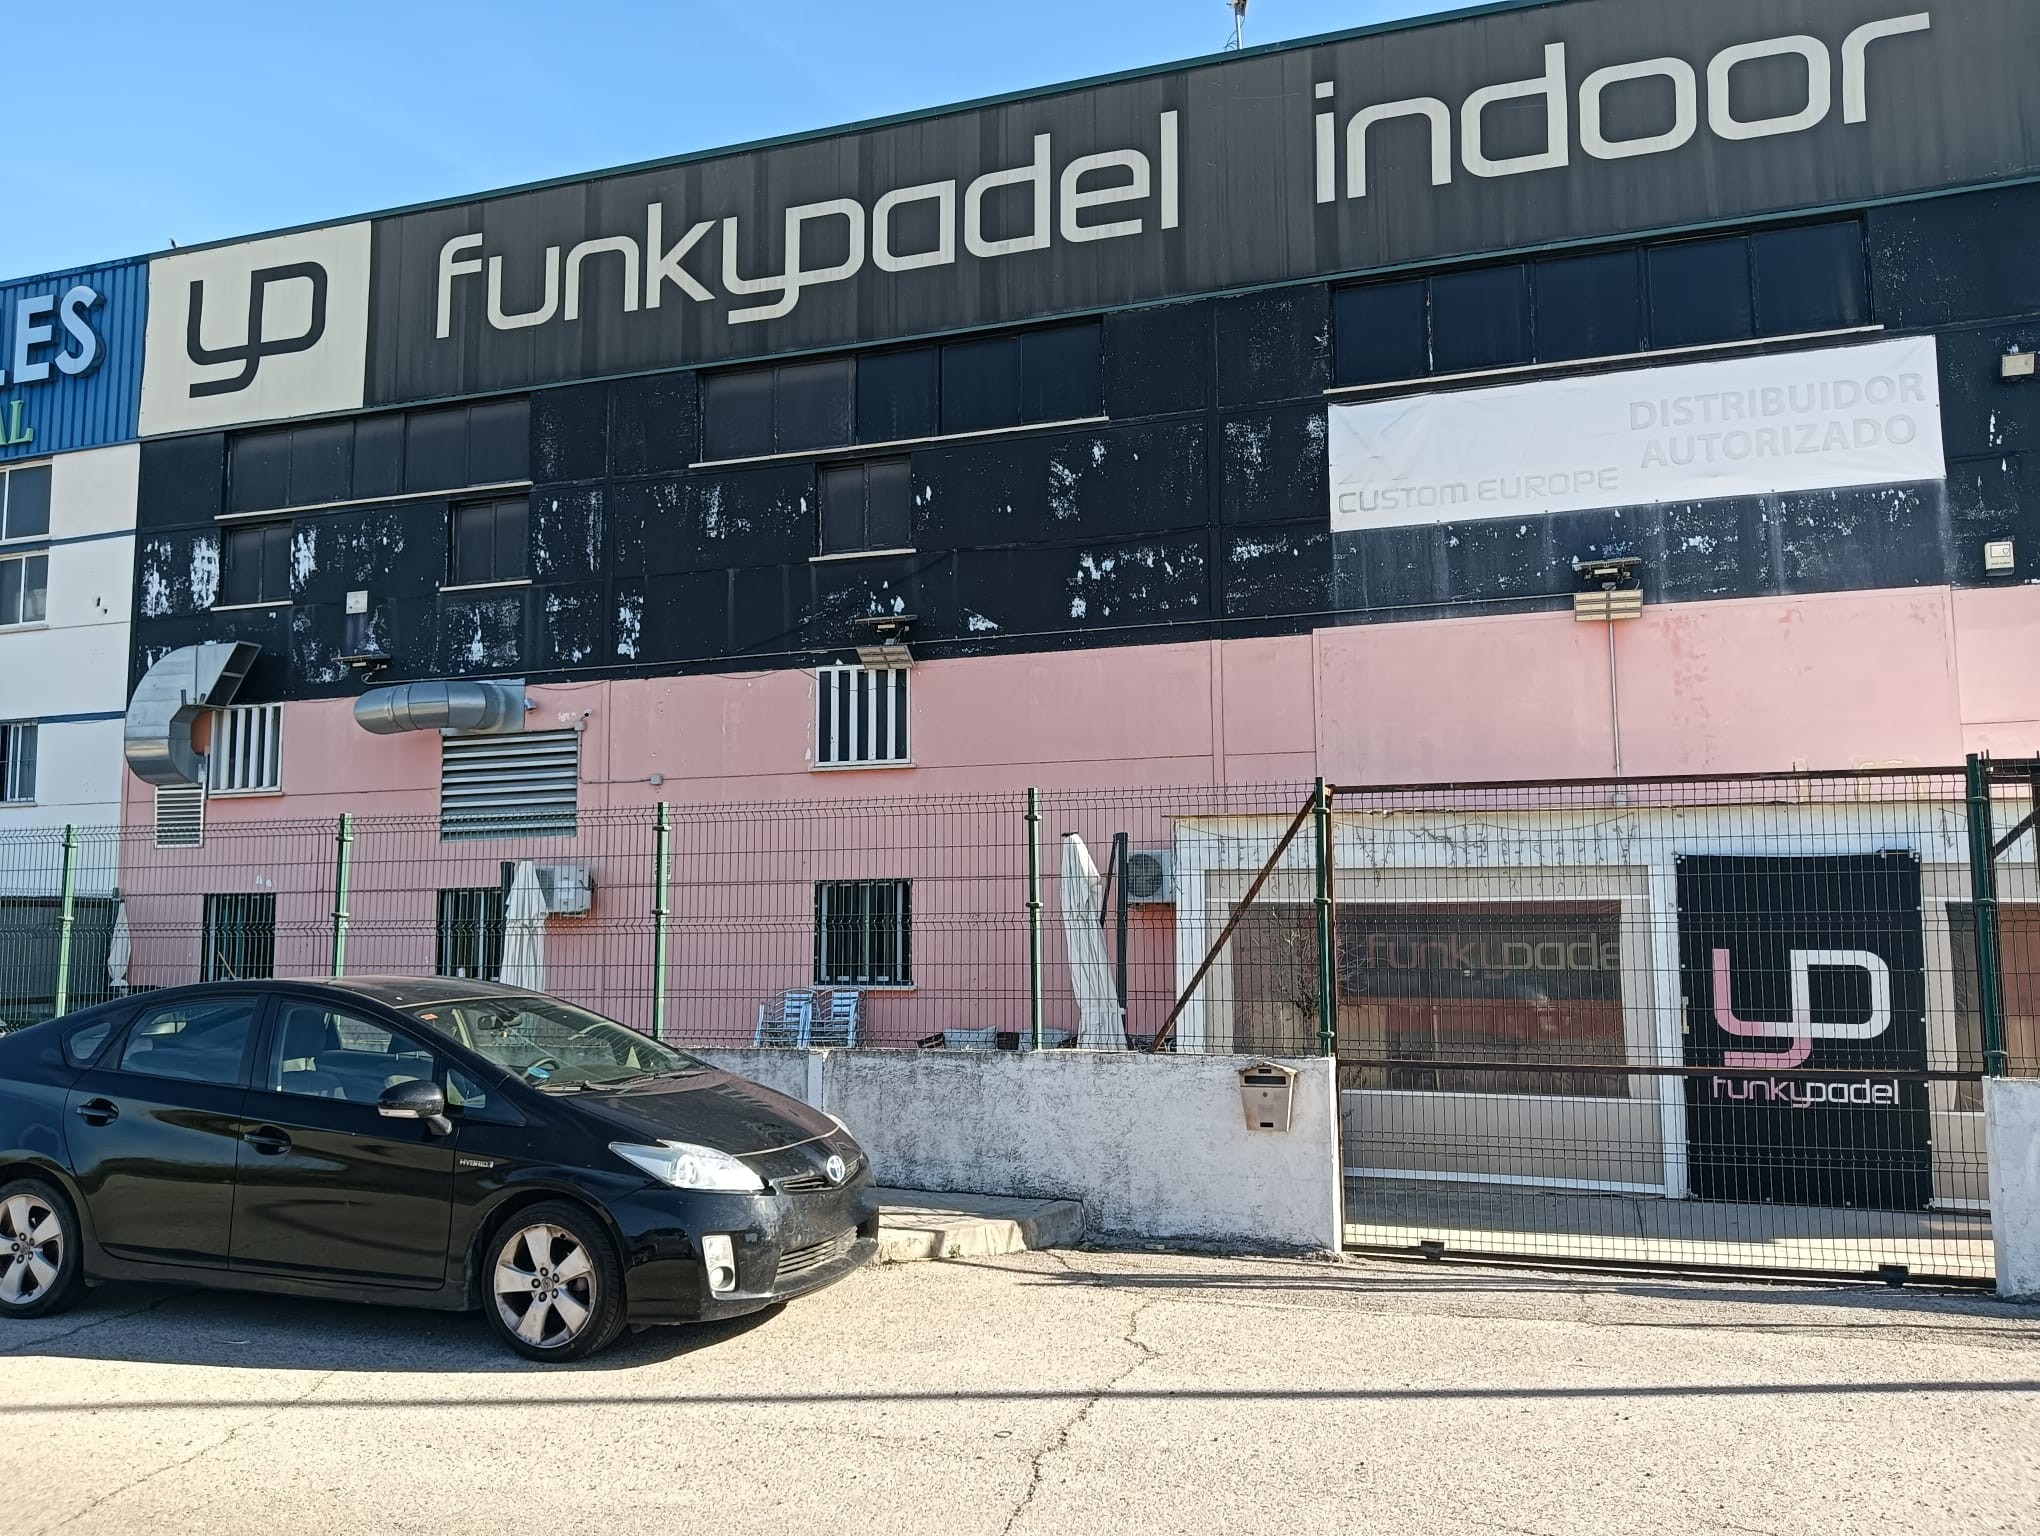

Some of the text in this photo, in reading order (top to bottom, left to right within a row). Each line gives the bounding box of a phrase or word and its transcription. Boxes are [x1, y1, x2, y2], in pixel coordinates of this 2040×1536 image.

[435, 12, 1931, 339] funkypadel indoor
[0, 285, 98, 386] ES
[1629, 372, 1926, 430] DISTRIBUIDOR
[1640, 414, 1917, 468] AUTORIZADO
[1477, 467, 1620, 501] EUROPE
[1712, 1075, 1900, 1108] funkypadel
